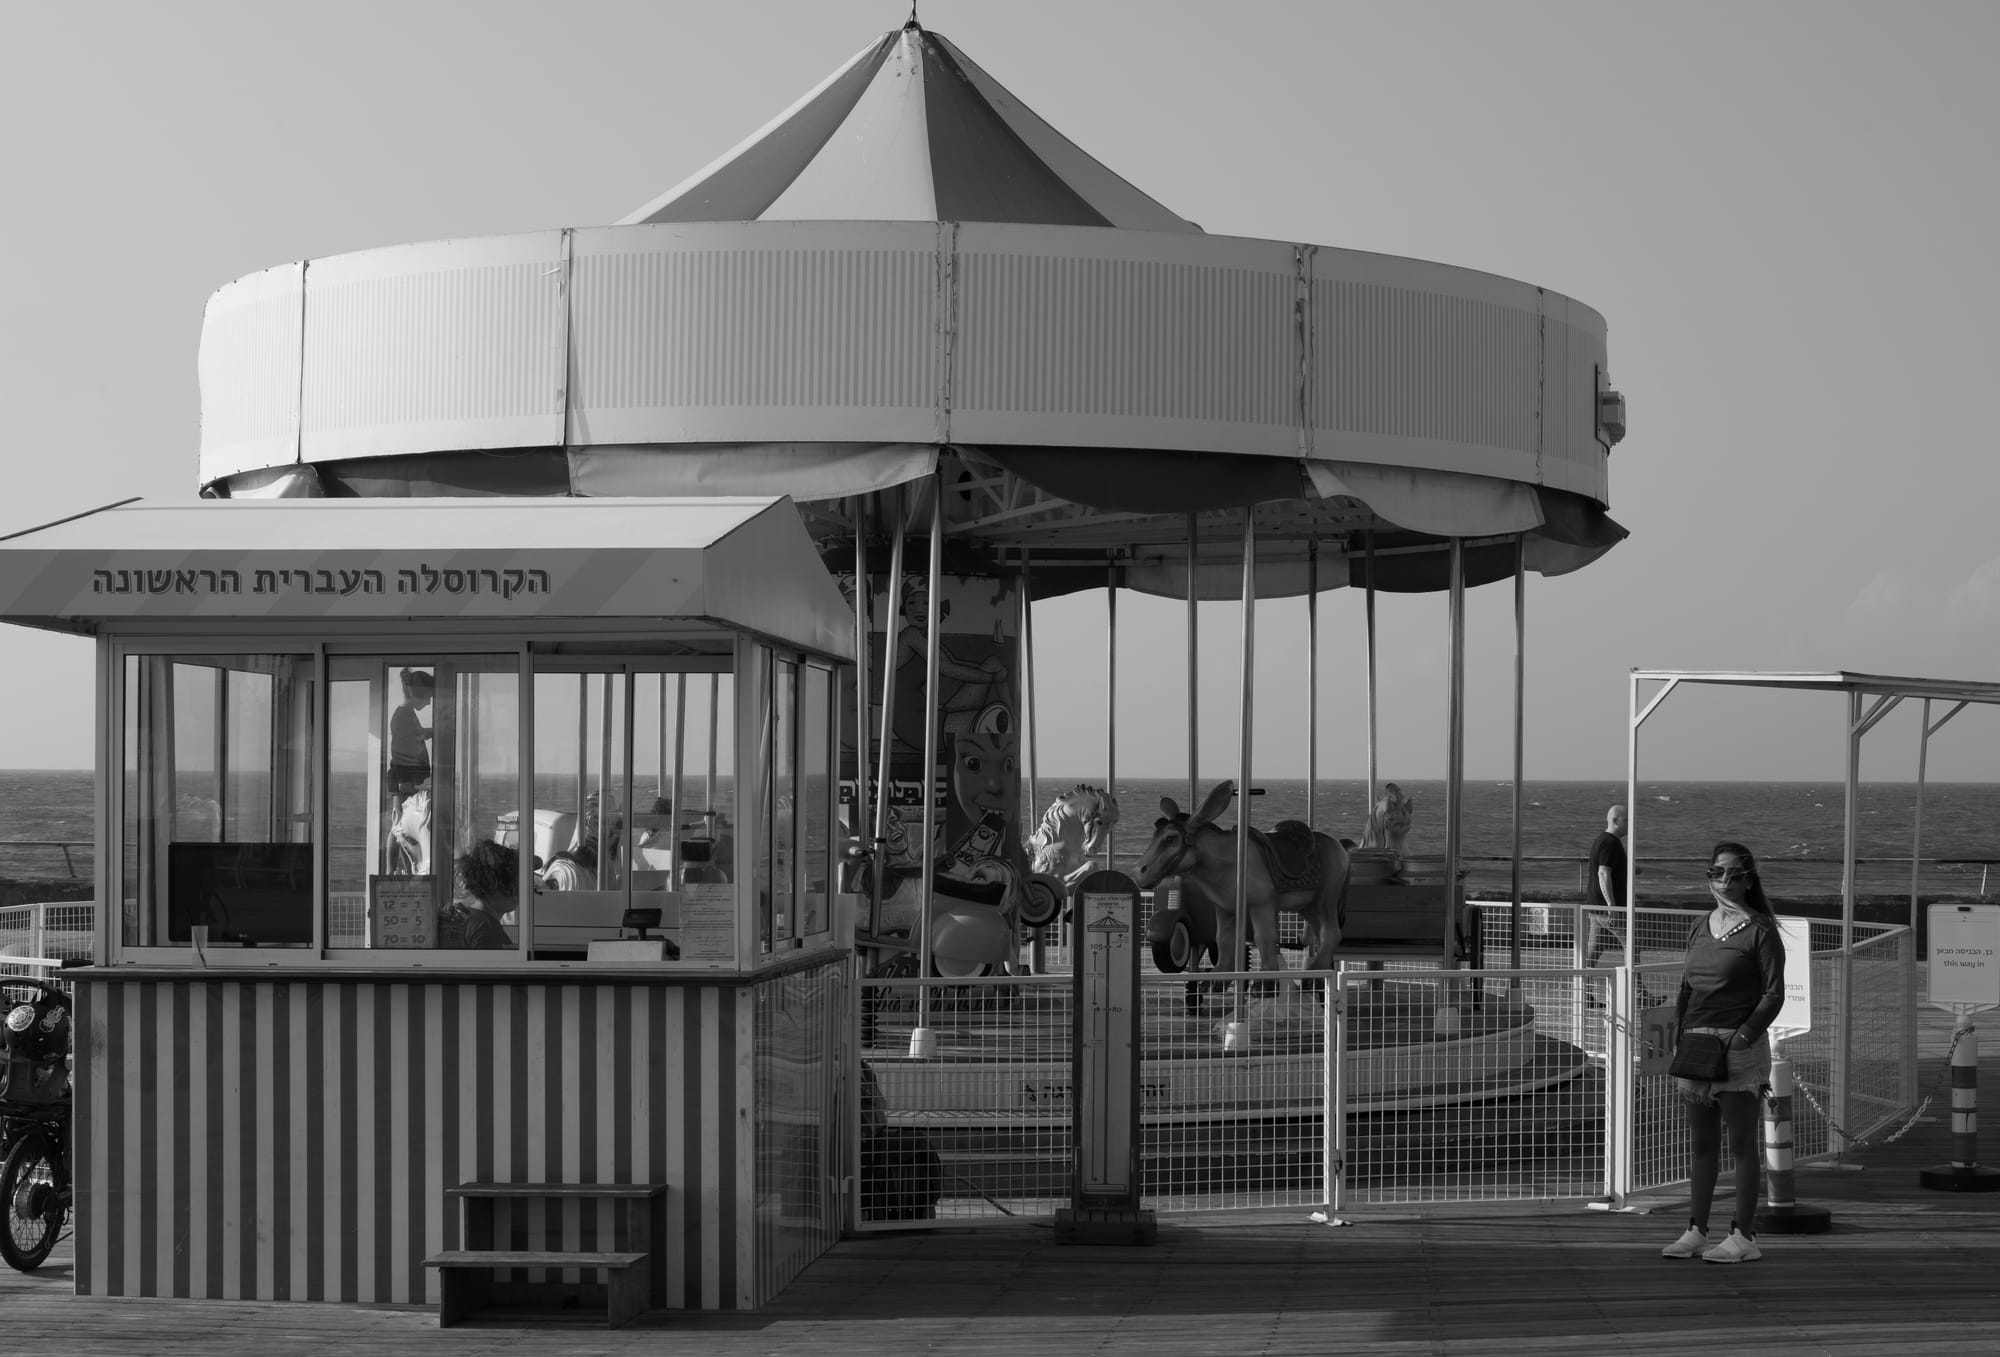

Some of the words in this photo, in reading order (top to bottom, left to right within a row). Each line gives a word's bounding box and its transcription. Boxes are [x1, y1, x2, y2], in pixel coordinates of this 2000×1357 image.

[93, 568, 240, 595] הראשונה
[252, 568, 385, 597] העברית
[397, 563, 551, 599] הקרוסלה
[383, 915, 399, 927] 50
[415, 915, 423, 927] 5
[383, 934, 399, 945] 70
[411, 934, 426, 945] 10
[1943, 959, 1959, 967] this
[1959, 961, 1976, 969] way
[1976, 959, 1985, 967] in
